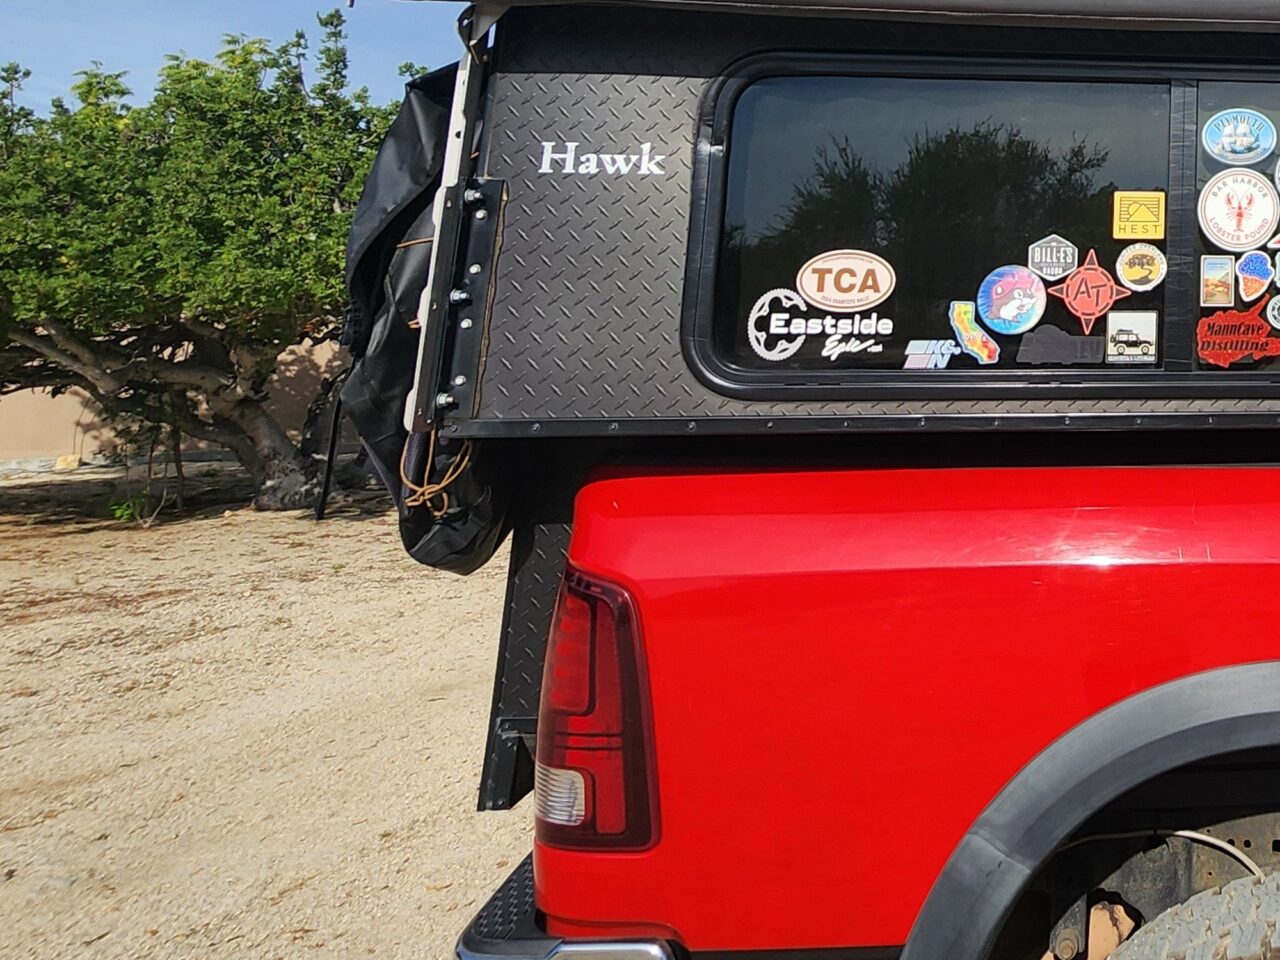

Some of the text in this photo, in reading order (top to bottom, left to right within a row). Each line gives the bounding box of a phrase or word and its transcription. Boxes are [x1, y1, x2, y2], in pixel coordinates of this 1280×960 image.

[1213, 113, 1266, 133] PLYMOUTH
[538, 141, 666, 175] Hawk
[1211, 180, 1229, 198] BAR
[1232, 176, 1269, 199] HARBOR
[1118, 224, 1161, 234] HEST
[1208, 216, 1270, 242] LOBSTER POUND
[811, 267, 881, 294] TCA
[769, 312, 894, 335] Eastside
[1207, 321, 1264, 336] MannCave
[821, 334, 875, 361] Epic
[1200, 339, 1269, 352] Distilling
